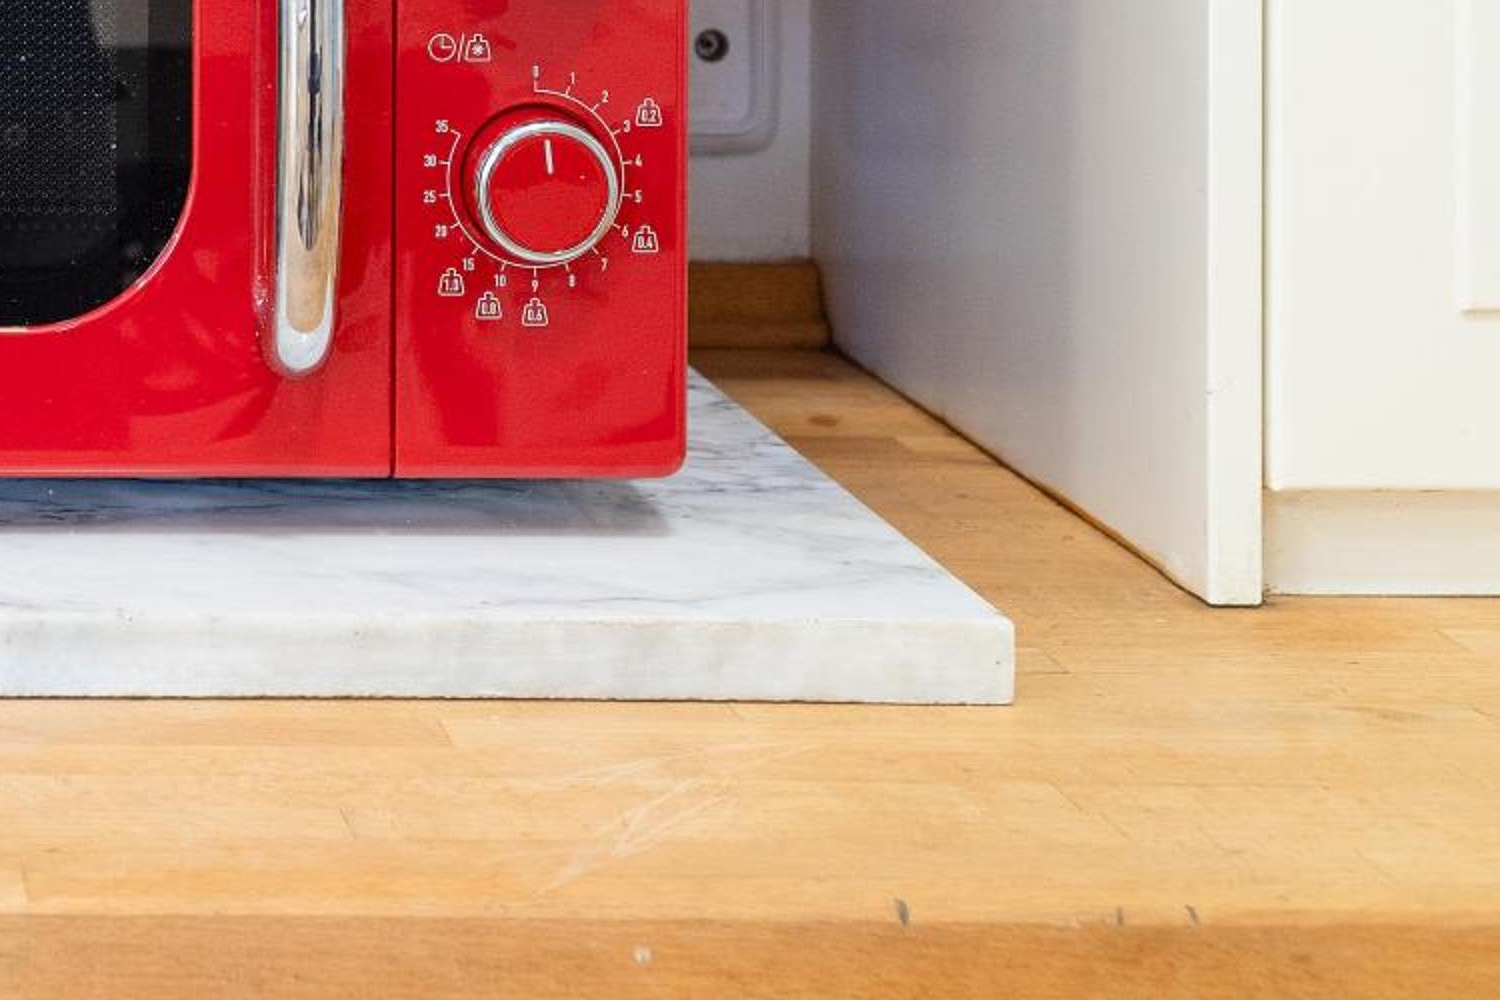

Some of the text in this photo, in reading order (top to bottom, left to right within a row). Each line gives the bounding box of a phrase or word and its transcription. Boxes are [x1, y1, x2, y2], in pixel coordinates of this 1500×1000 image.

[570, 72, 576, 84] 1
[602, 91, 609, 103] 2
[641, 109, 657, 123] 0.2
[435, 120, 449, 133] 35
[623, 120, 631, 132] 3
[423, 154, 437, 167] 30
[635, 154, 643, 167] 4
[423, 190, 437, 203] 25
[635, 190, 642, 202] 5
[435, 225, 448, 238] 20
[621, 224, 629, 237] 6
[463, 258, 475, 271] 15
[601, 259, 608, 271] 7
